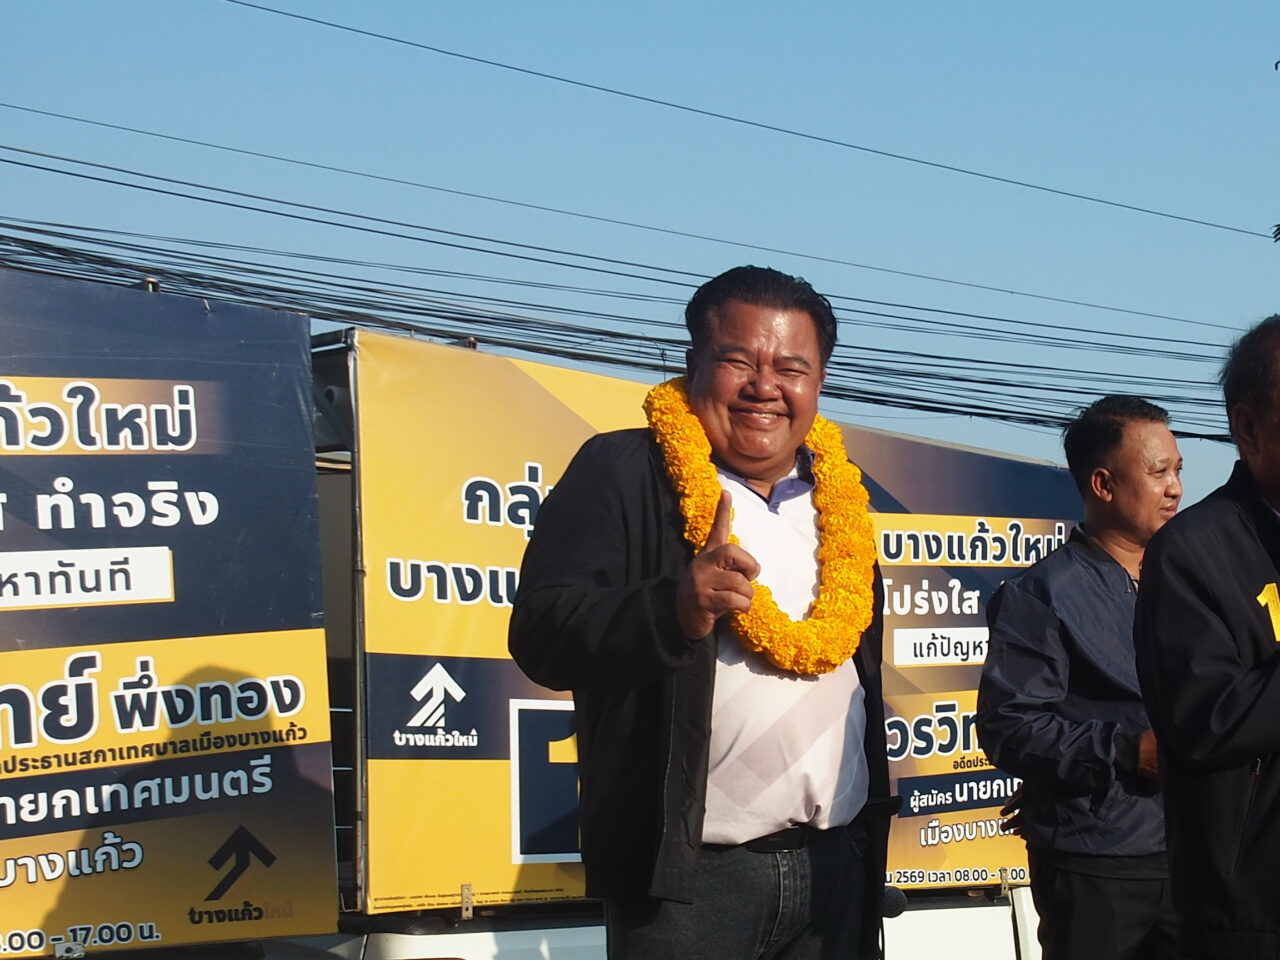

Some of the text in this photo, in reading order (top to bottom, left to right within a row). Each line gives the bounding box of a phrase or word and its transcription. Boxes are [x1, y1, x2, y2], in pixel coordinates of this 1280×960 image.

[36, 476, 220, 530] ทำจริง
[462, 462, 554, 541] กลุ่
[883, 578, 980, 615] โปร่งใส
[110, 655, 306, 734] พึ่งทอง
[0, 721, 308, 775] ประธานสภาเทศบาลเมืองบางแก้ว
[393, 728, 479, 748] บางแก้วใหม่
[910, 789, 953, 813] ผู้สมัคร
[896, 870, 925, 884] 2569
[927, 870, 952, 883] เวลา
[954, 868, 988, 882] 08.00
[0, 929, 47, 953] .00
[68, 922, 134, 946] 17.00
[138, 921, 162, 941] น.
